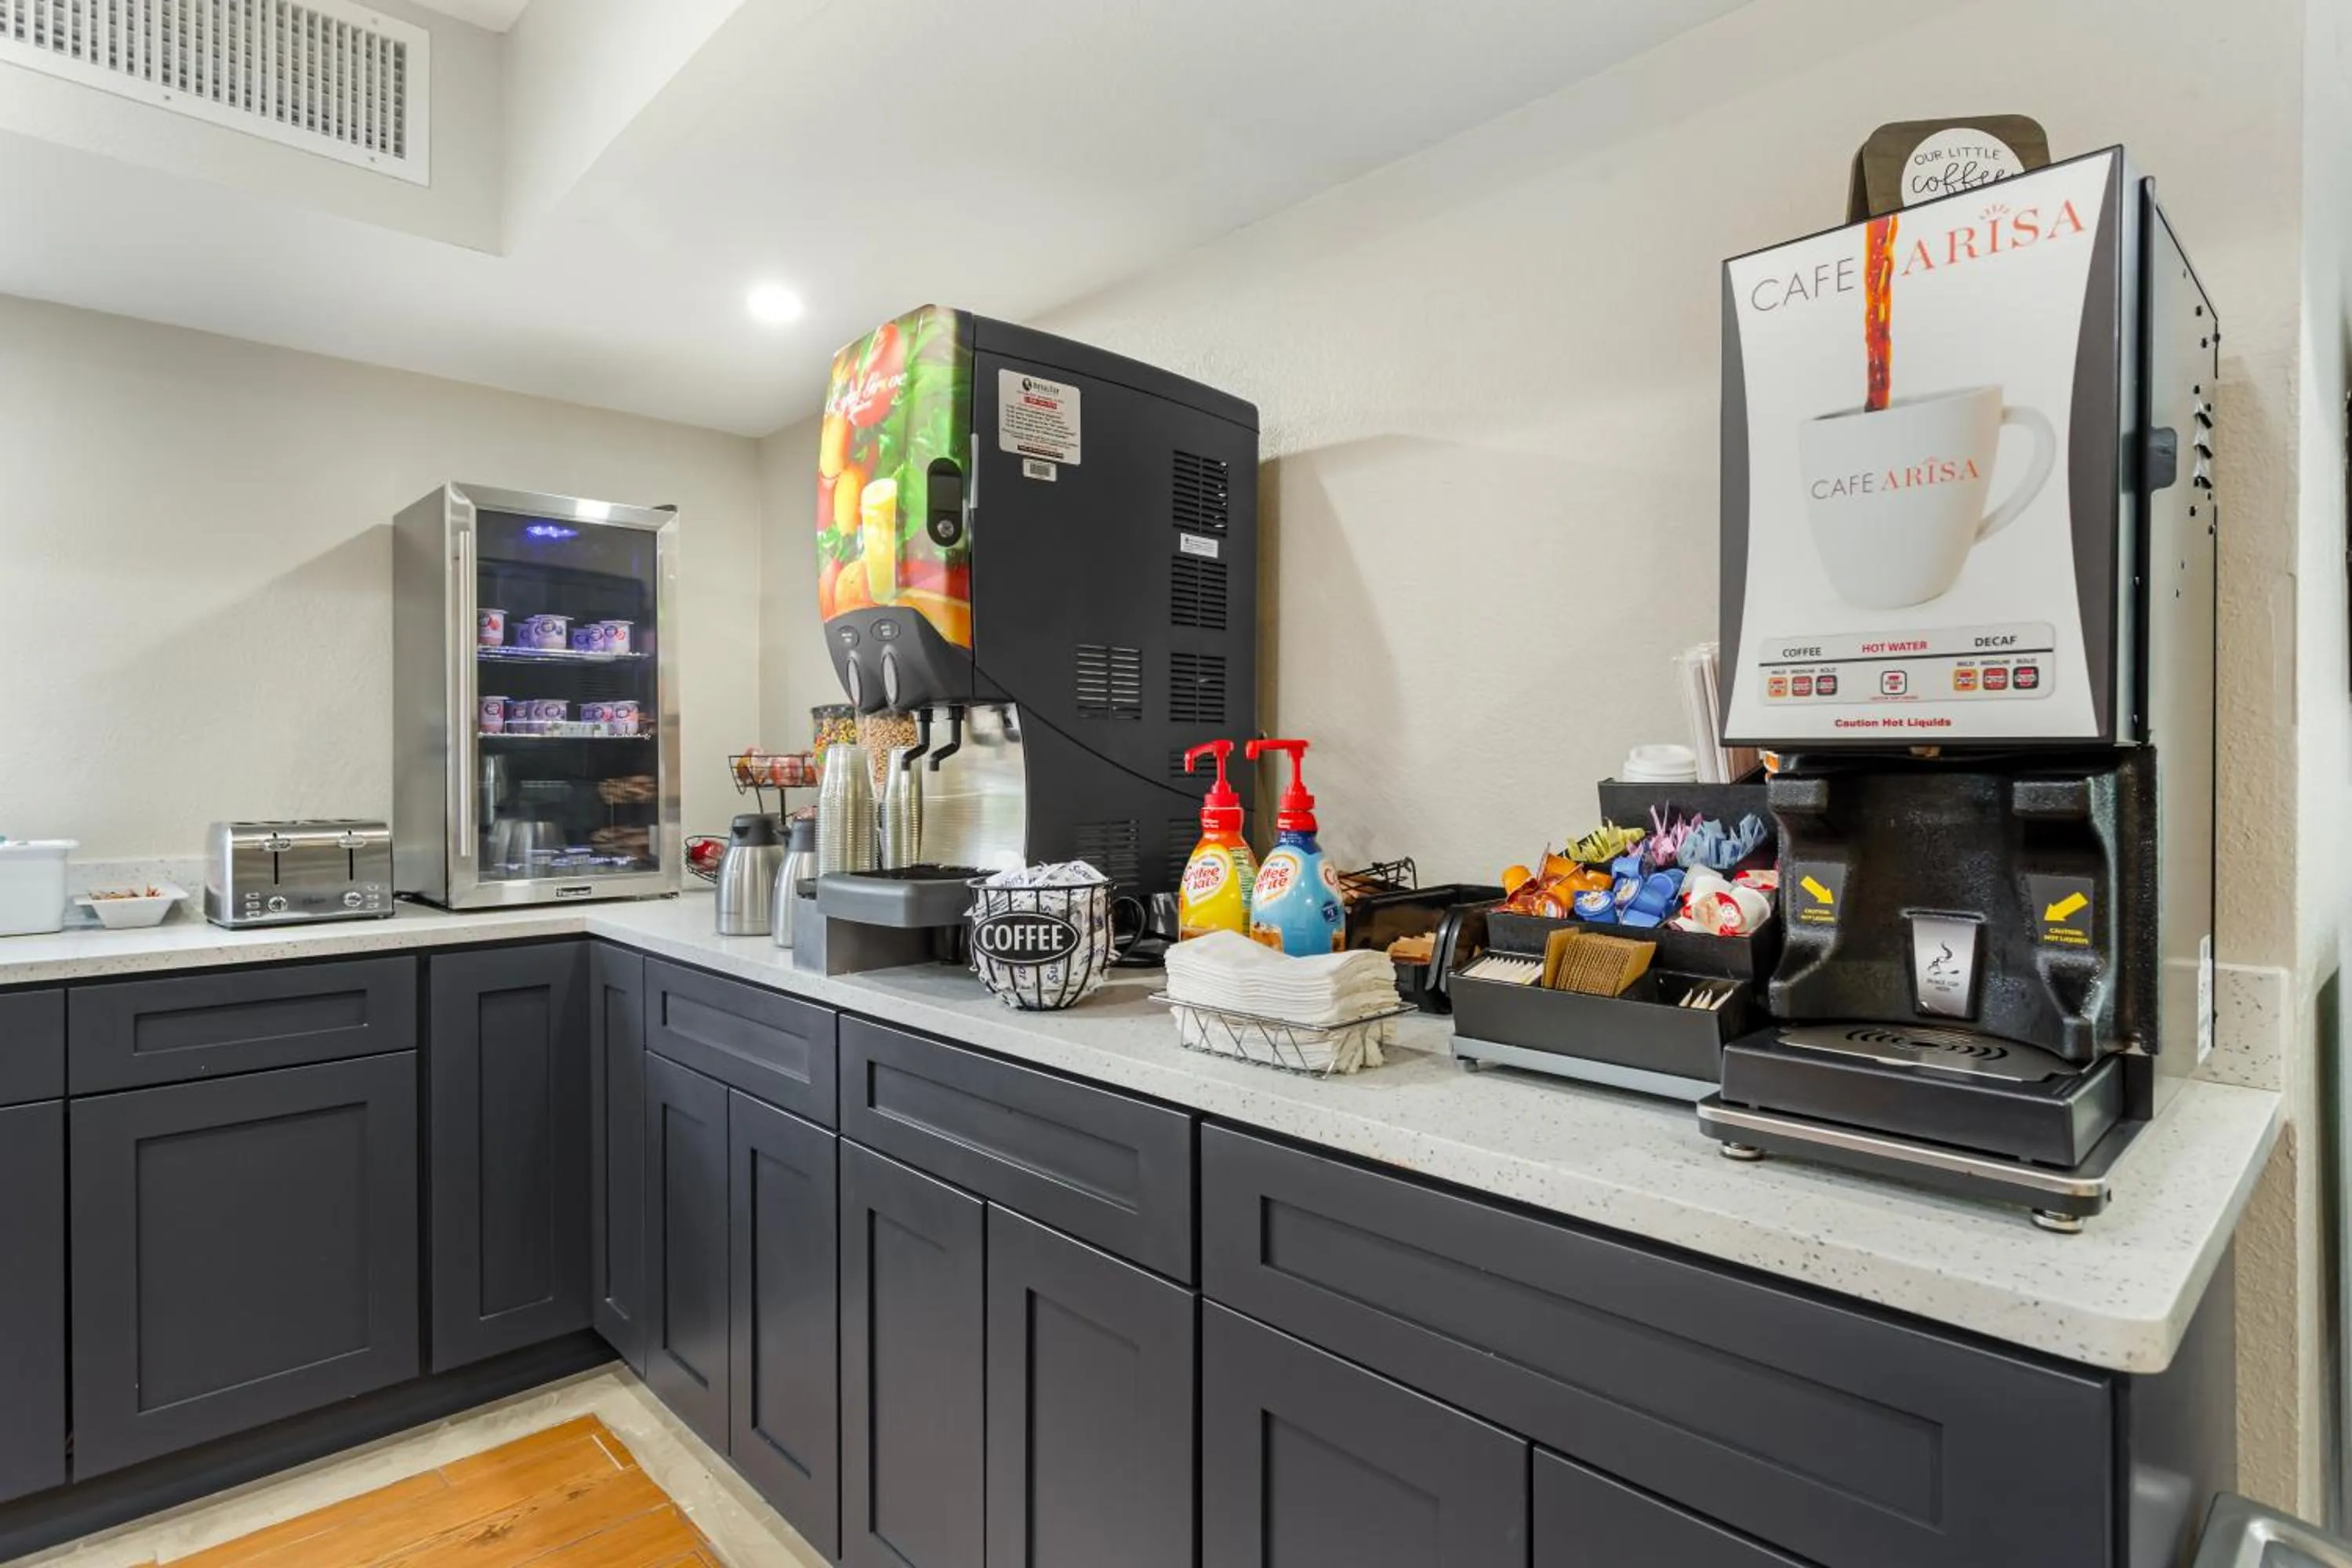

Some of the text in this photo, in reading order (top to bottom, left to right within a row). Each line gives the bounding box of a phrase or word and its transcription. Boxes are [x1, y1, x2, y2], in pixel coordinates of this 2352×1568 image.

[1914, 147, 2002, 165] OUR LITTLE
[1751, 199, 2087, 313] CAFE ARISA
[1811, 457, 1980, 500] CAFE ARISA
[1862, 641, 1928, 653] HOT WATER
[1974, 636, 2017, 647] DECAF
[1782, 647, 1822, 659] COFFEE
[1835, 717, 1951, 729] Caution Hot Liquids
[981, 924, 1064, 951] COFFEE
